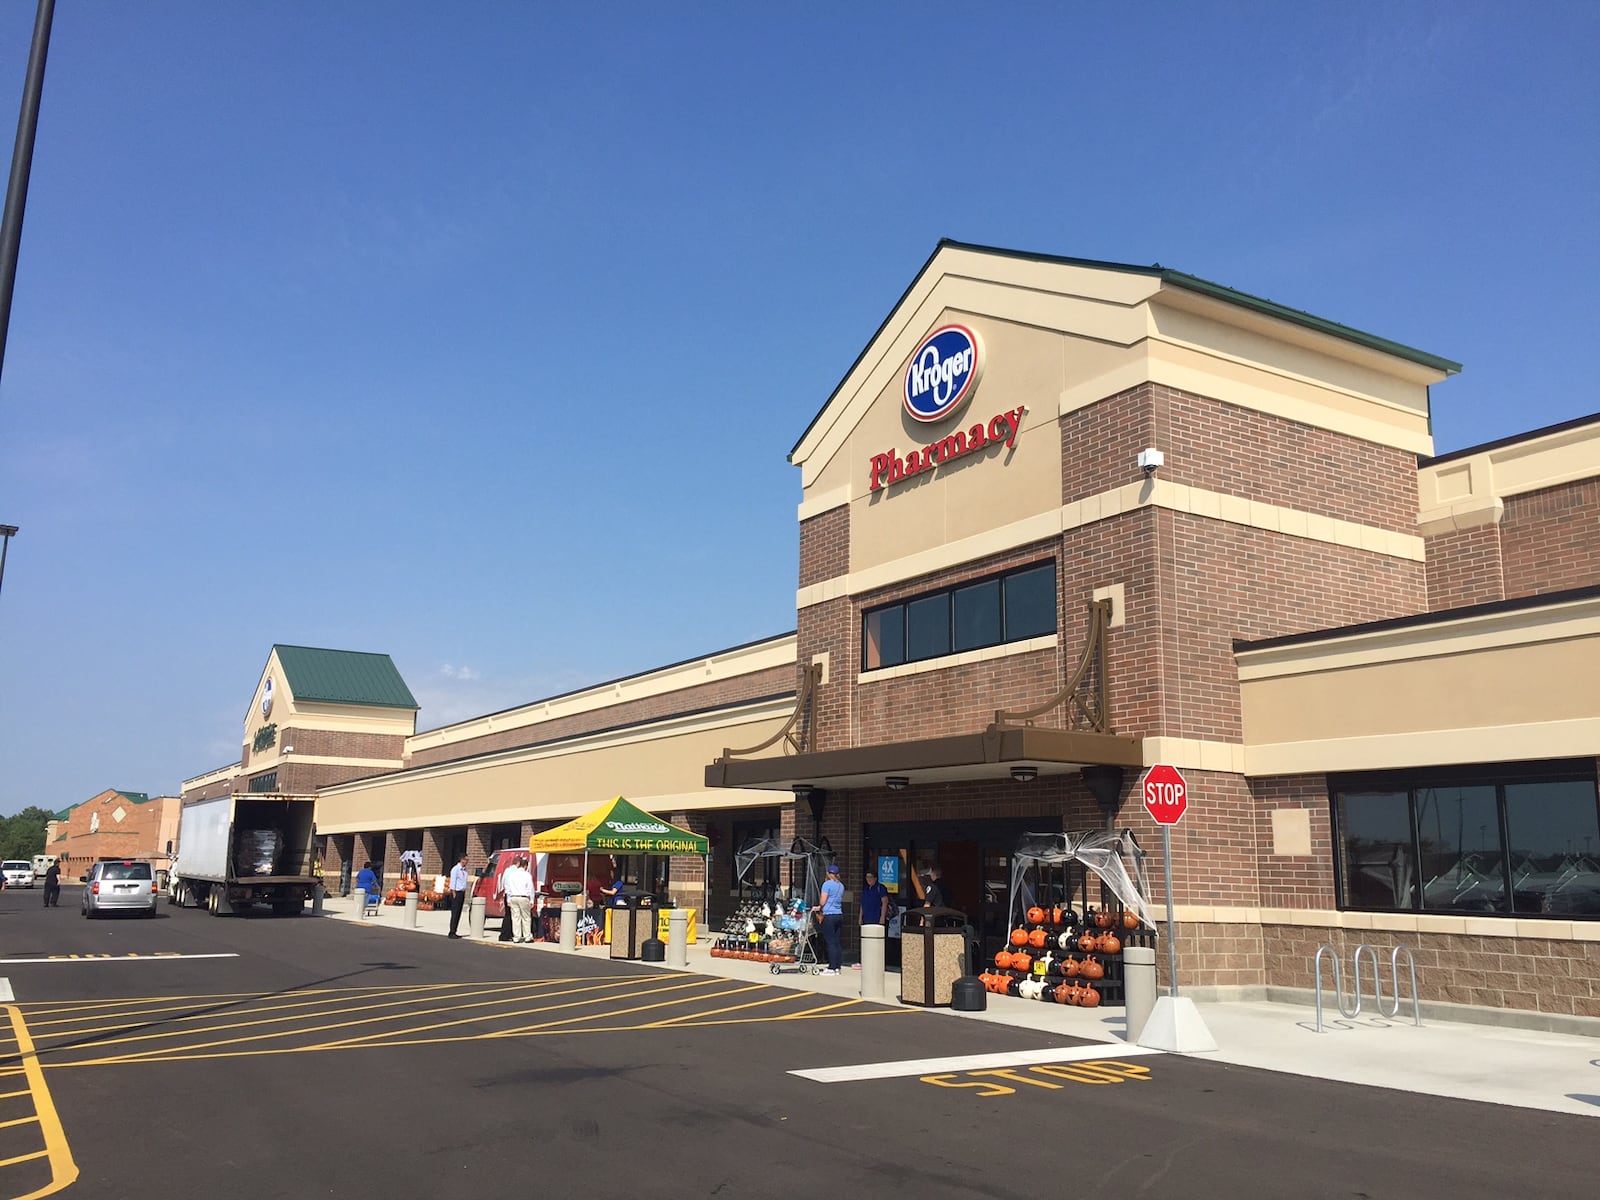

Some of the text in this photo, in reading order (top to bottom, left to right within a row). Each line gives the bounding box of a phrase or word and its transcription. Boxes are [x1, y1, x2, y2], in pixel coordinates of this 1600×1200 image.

[911, 345, 972, 406] Kroger
[869, 405, 1026, 491] Pharmacy
[1146, 782, 1184, 806] STOP
[605, 821, 671, 834] Nathan's
[596, 838, 620, 849] THIS
[622, 839, 632, 849] IS
[634, 839, 653, 850] THE
[656, 840, 699, 853] ORIGINAL
[881, 860, 894, 874] 4X
[919, 1060, 1153, 1098] STOP
